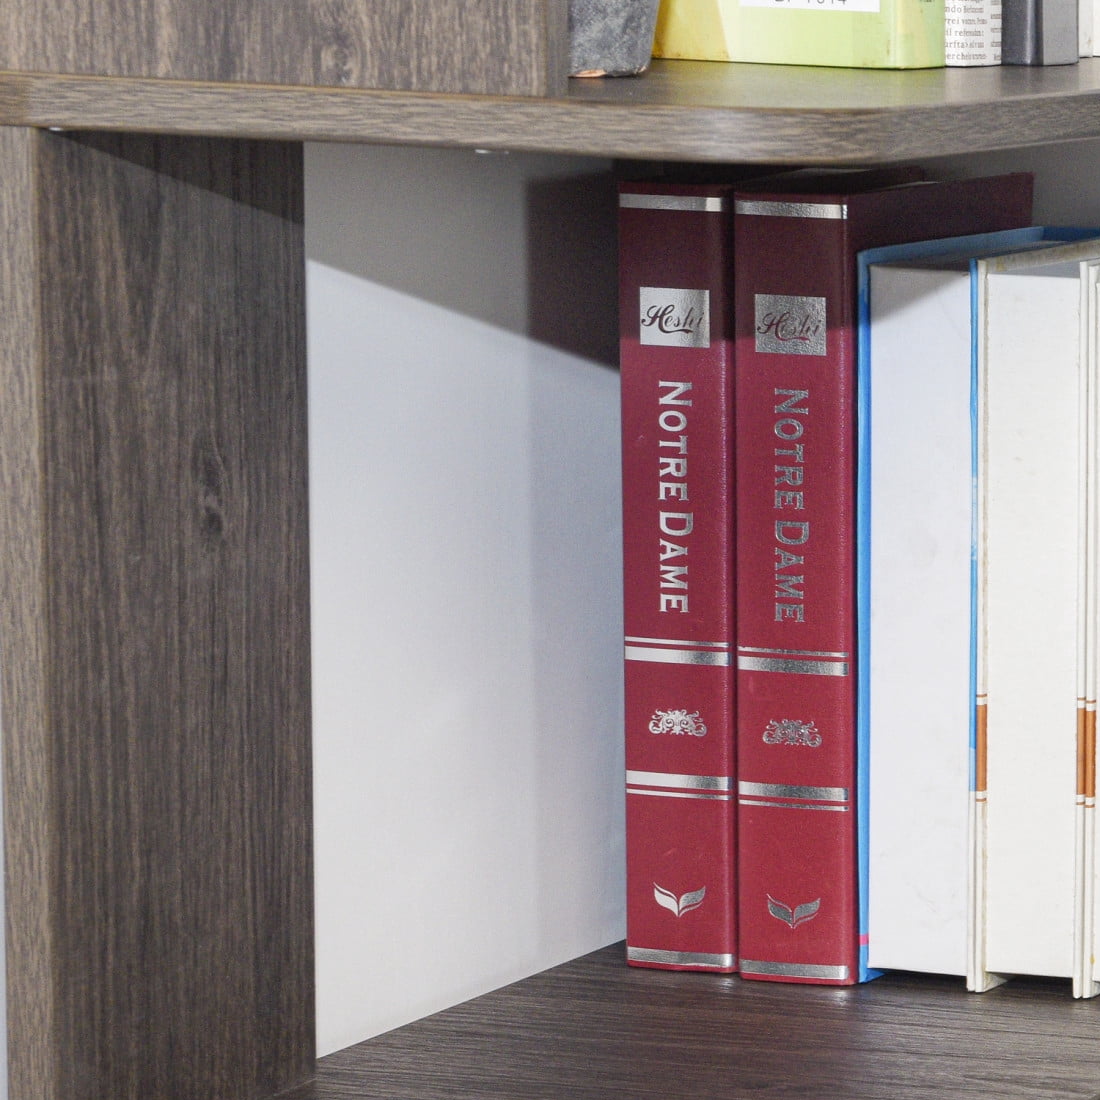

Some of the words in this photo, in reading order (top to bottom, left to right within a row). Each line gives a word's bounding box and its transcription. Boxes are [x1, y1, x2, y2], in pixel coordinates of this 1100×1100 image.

[658, 380, 693, 501] NOTRE
[774, 387, 809, 510] NOTRE
[658, 511, 694, 614] DAME
[774, 519, 809, 623] DAME
